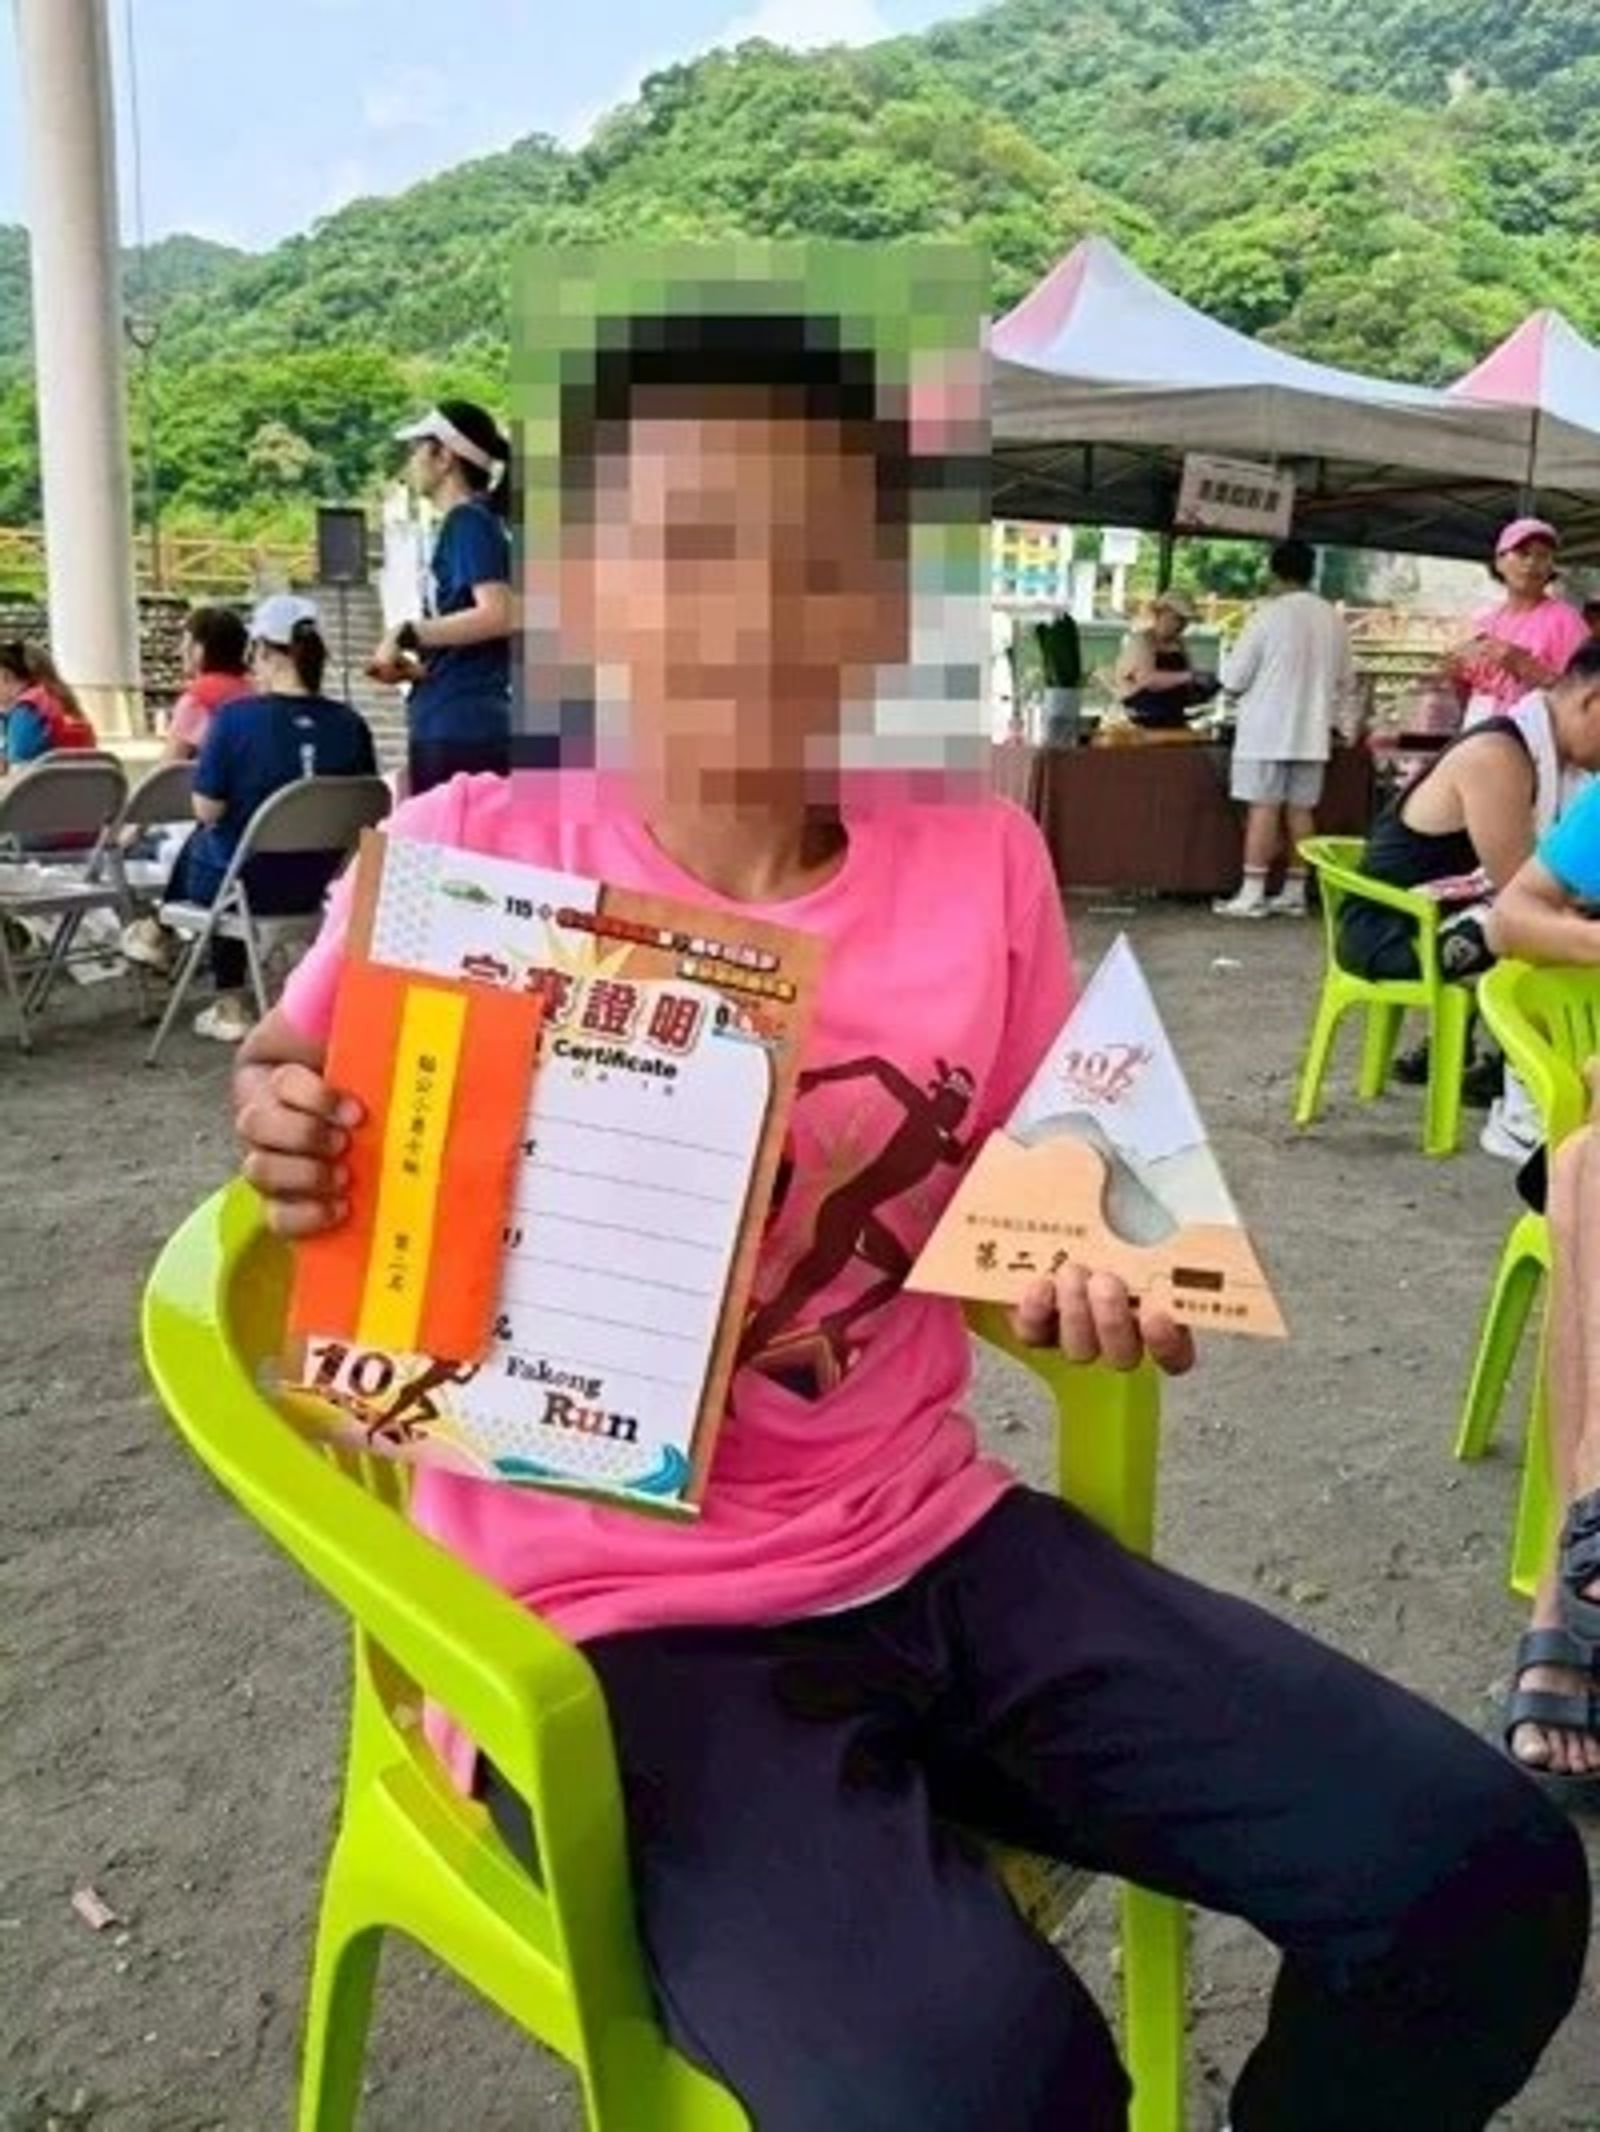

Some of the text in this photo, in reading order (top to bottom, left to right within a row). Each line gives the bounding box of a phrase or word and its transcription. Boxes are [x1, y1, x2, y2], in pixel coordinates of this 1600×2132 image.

[552, 1038, 678, 1080] Certificate
[505, 1355, 603, 1400] Fakong
[540, 1390, 638, 1443] Run
